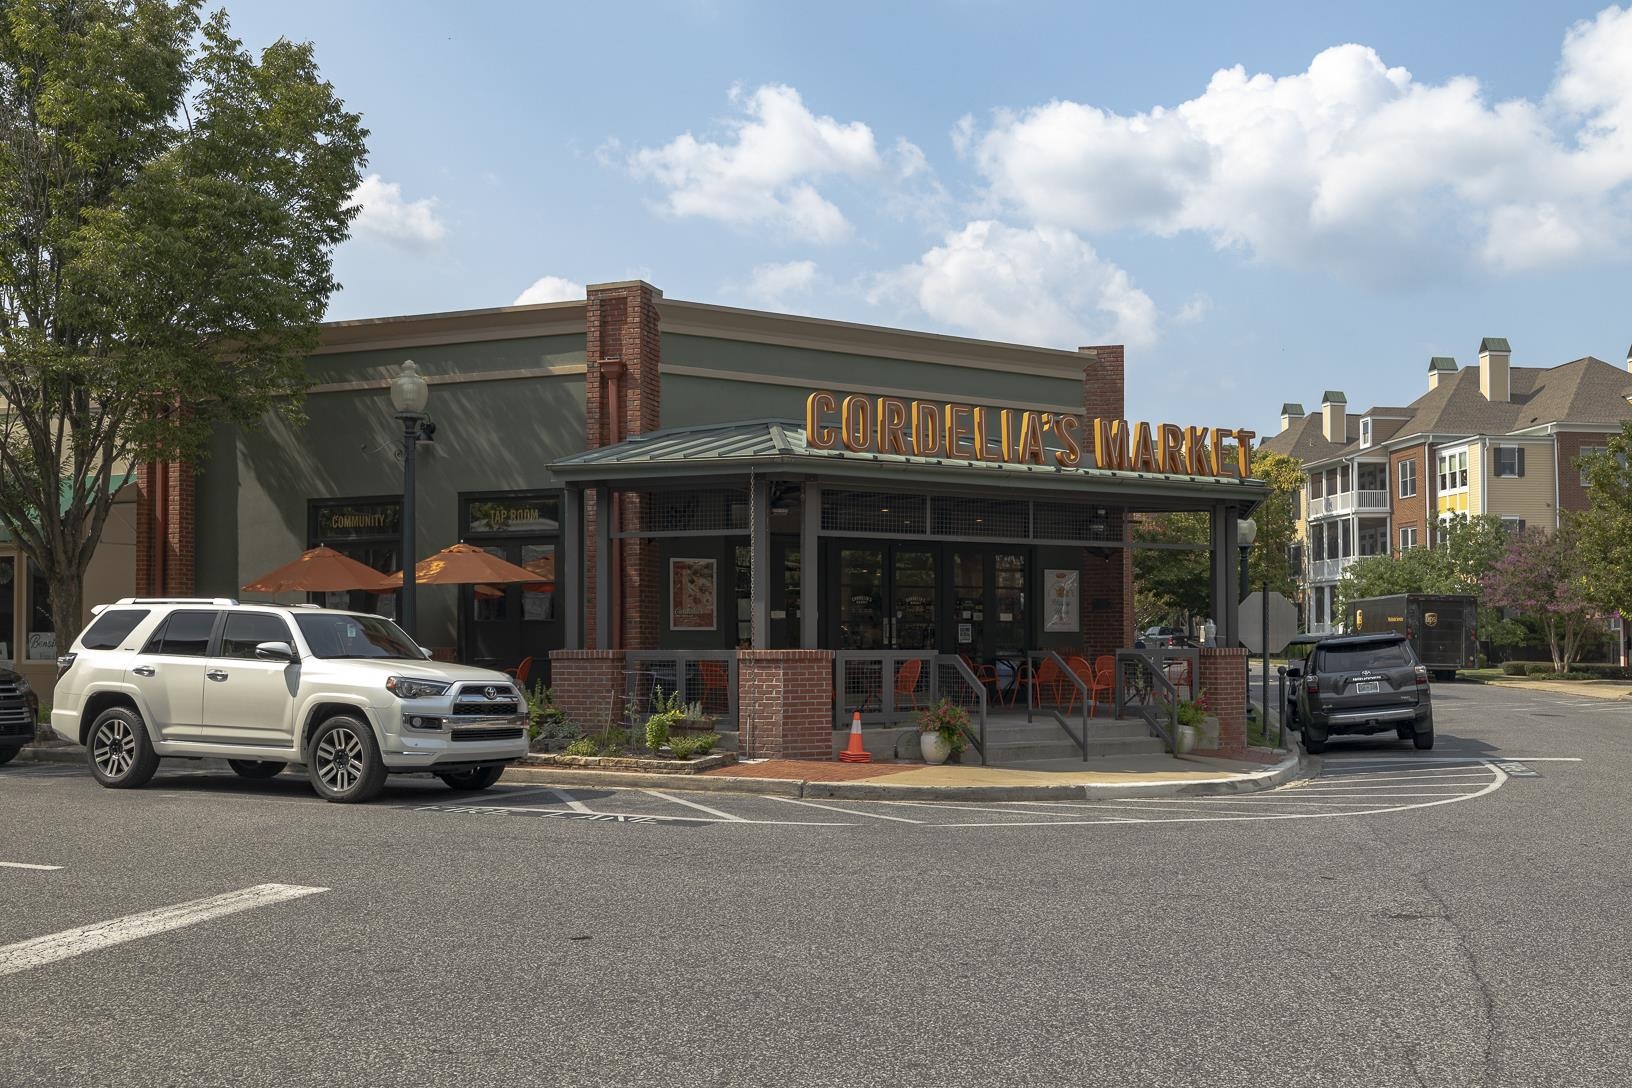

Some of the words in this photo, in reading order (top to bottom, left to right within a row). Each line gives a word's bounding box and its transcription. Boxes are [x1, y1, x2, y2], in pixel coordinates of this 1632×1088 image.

[806, 391, 1081, 468] CORDELIA'S
[1093, 417, 1256, 478] MARKET
[332, 513, 385, 529] COMMUNITY
[489, 509, 507, 524] TAP
[510, 507, 539, 522] ROOM
